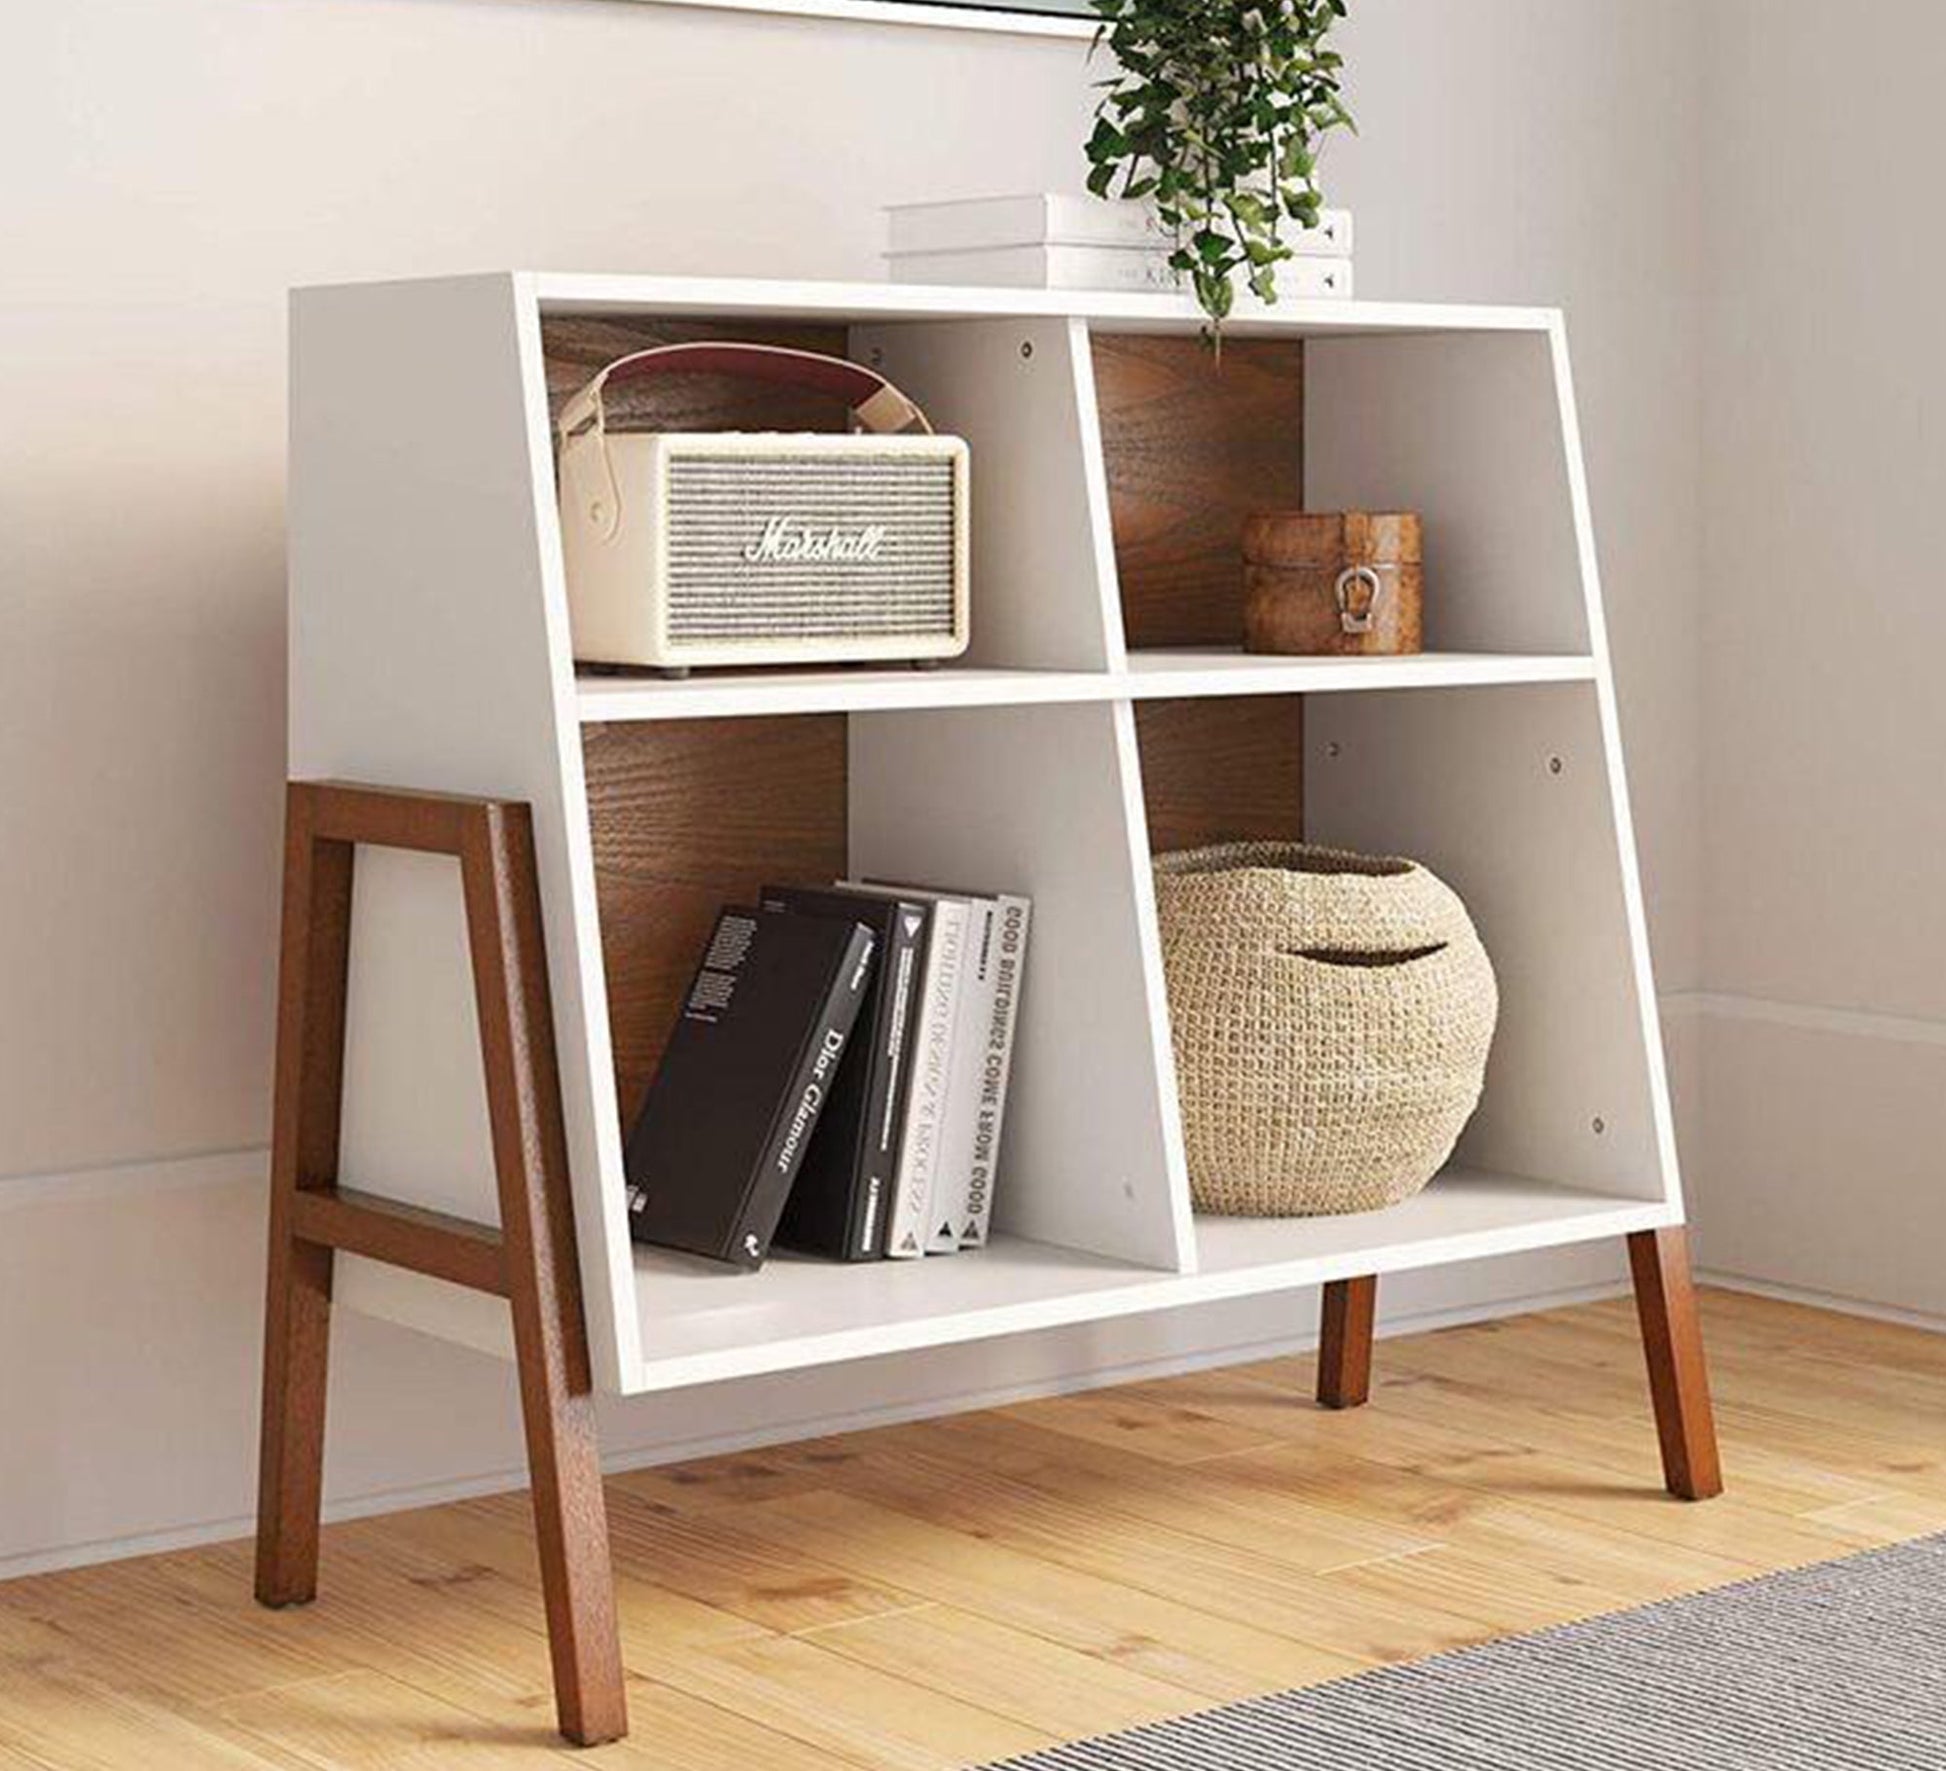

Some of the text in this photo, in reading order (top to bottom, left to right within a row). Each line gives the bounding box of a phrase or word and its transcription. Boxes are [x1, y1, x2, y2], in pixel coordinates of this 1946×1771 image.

[745, 516, 887, 562] Marshall
[777, 1029, 844, 1174] Dior Glamour
